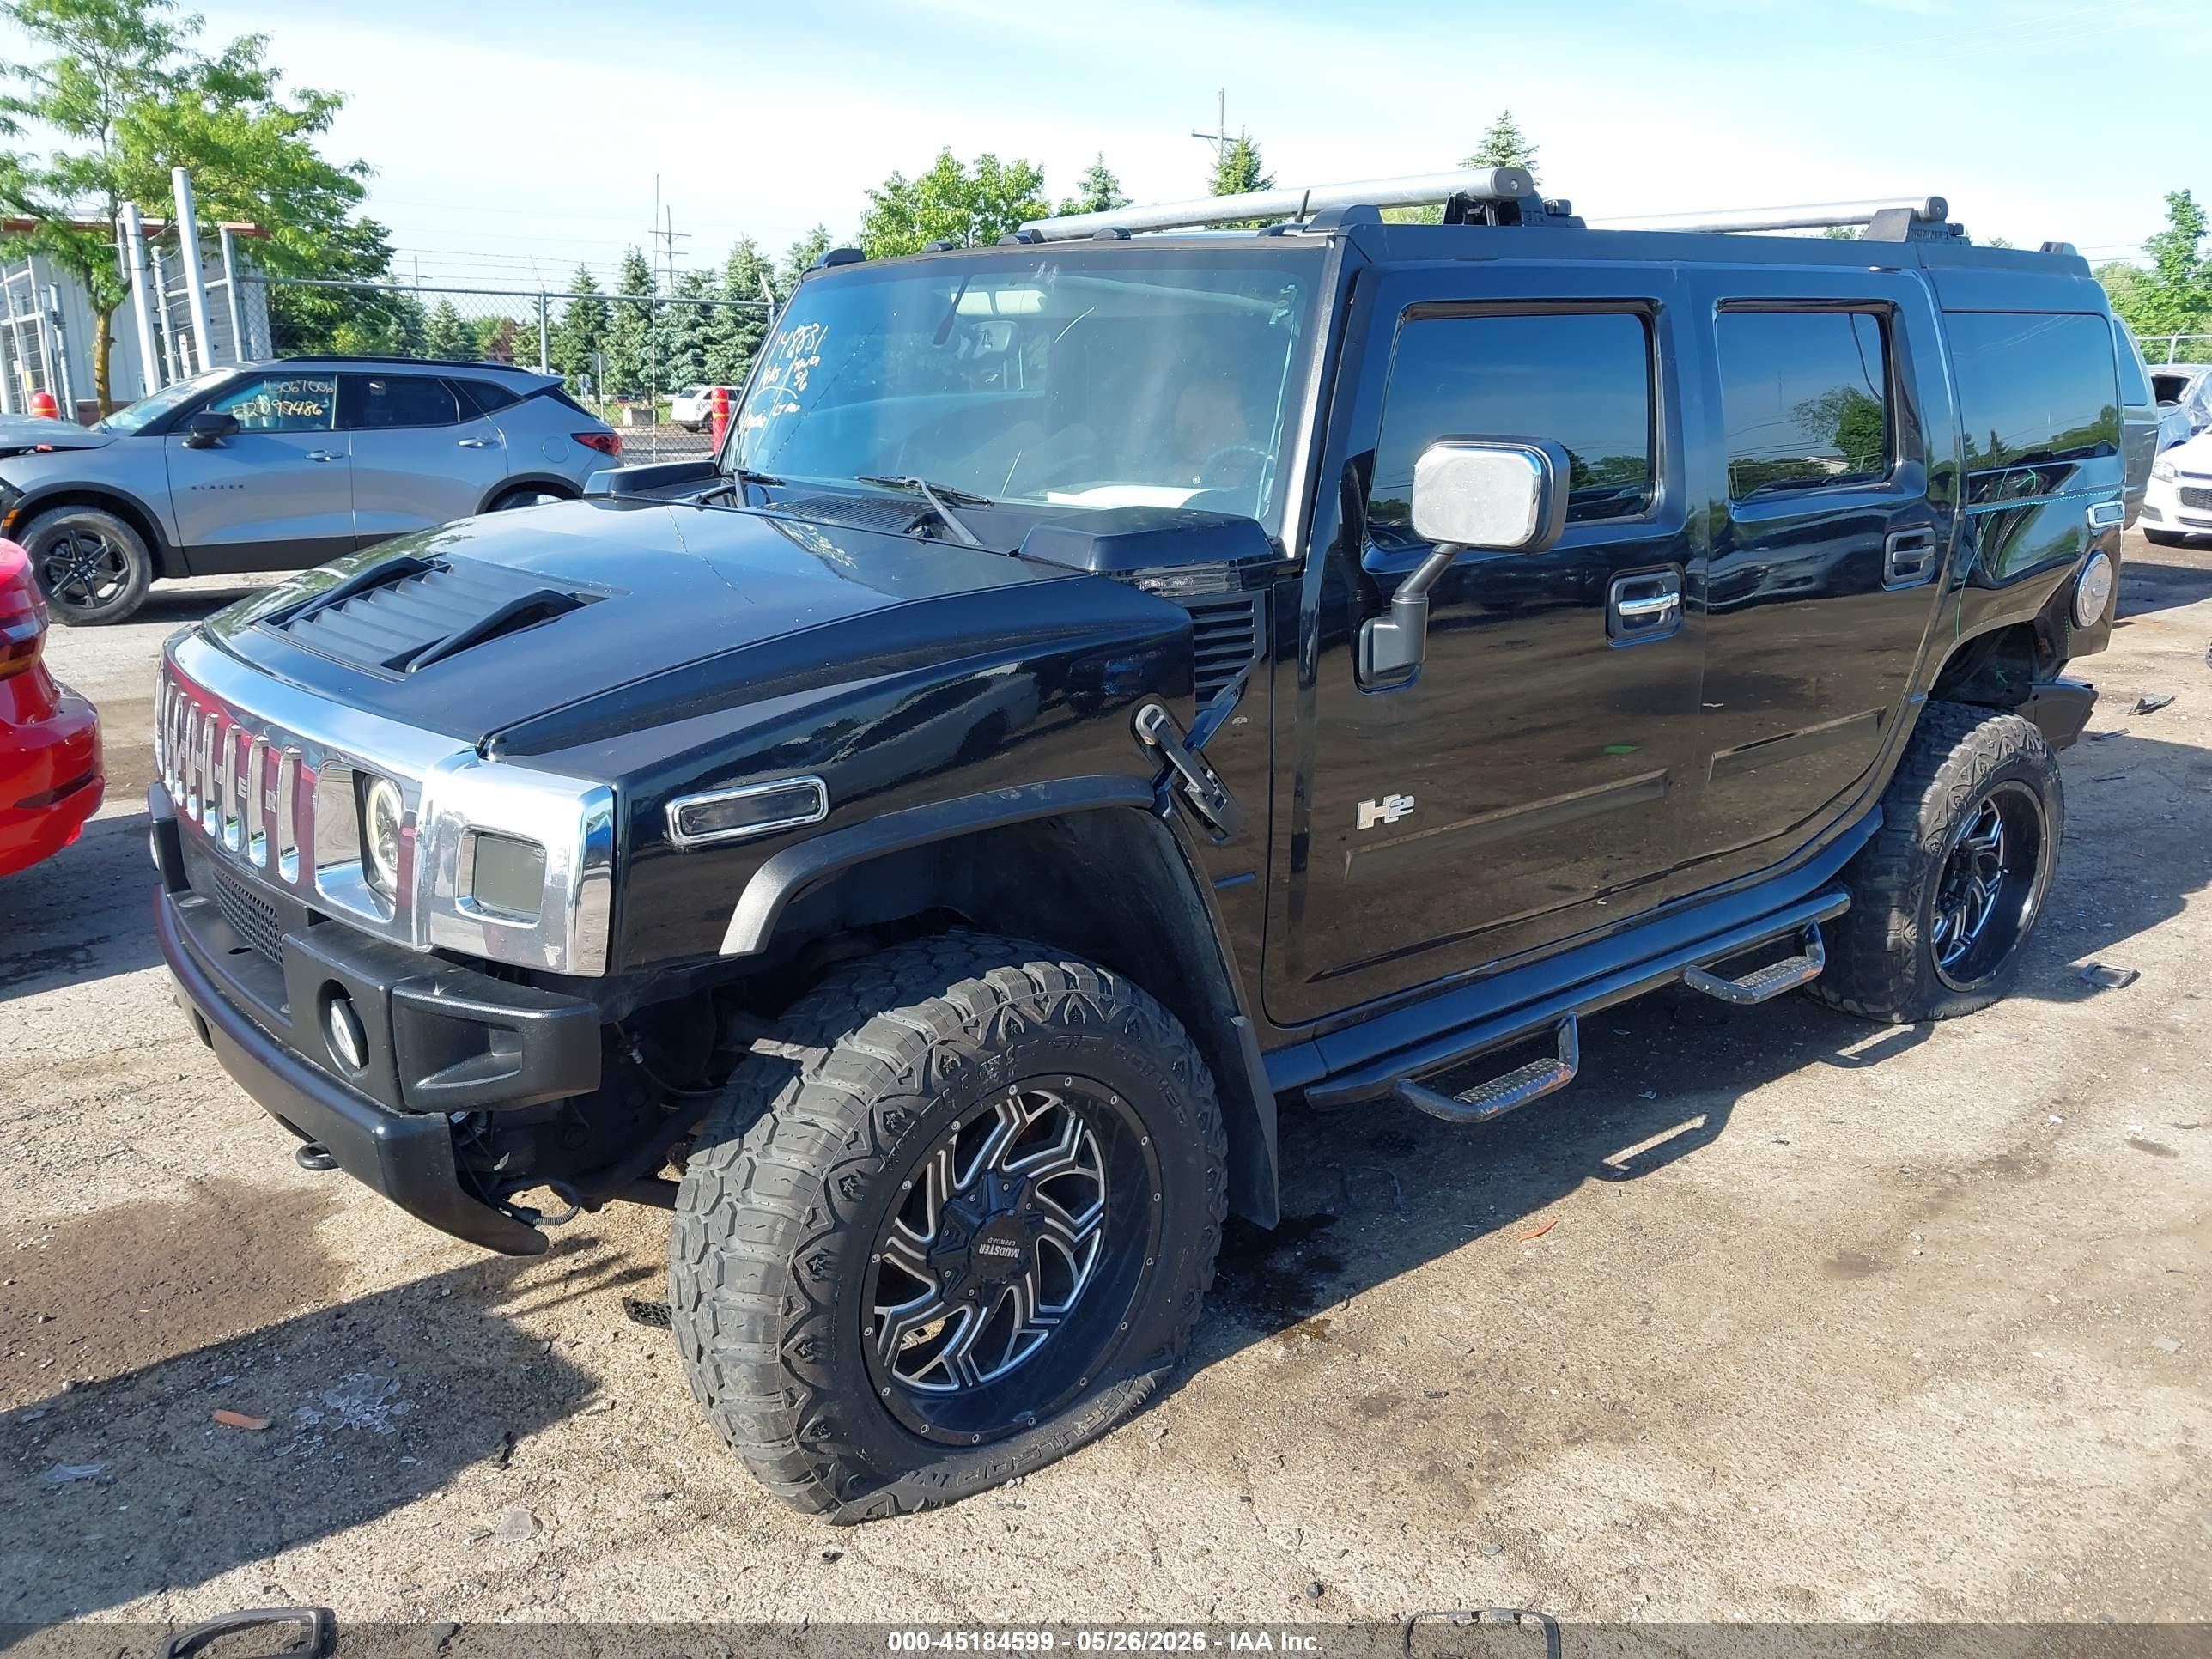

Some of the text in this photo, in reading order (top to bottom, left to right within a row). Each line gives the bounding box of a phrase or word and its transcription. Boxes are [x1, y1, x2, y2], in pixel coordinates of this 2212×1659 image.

[1357, 793, 1415, 830] H2
[988, 1237, 1017, 1246] OFFROAD
[979, 1243, 1020, 1259] MUDSTER
